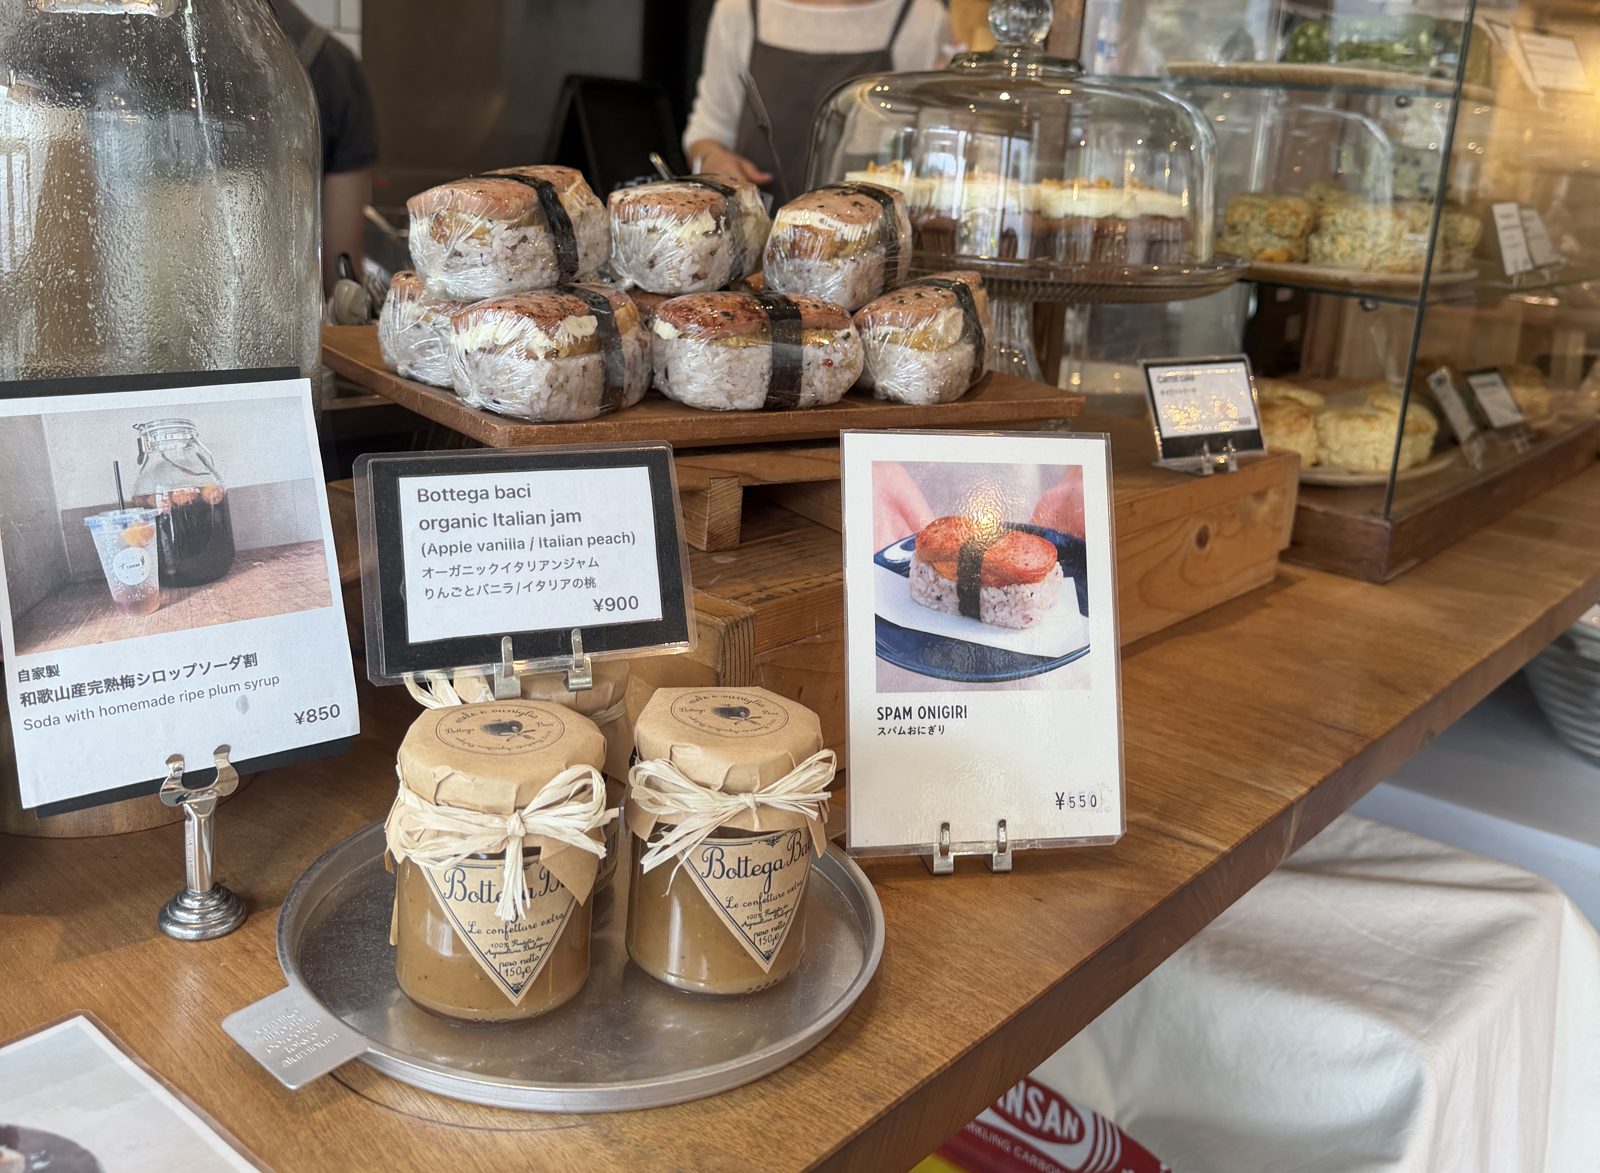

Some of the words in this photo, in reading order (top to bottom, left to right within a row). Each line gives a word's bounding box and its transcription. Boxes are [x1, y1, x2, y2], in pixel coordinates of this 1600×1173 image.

[417, 487, 490, 504] Bottega
[494, 483, 532, 500] baci
[419, 512, 488, 532] organic
[493, 510, 546, 527] Italian
[550, 509, 582, 527] jam
[421, 541, 473, 558] (Apple
[476, 537, 525, 552] vanilla
[538, 534, 583, 549] Italian
[587, 531, 636, 548] peach)
[422, 557, 600, 579] オーガニックイタリアンジャム
[593, 595, 639, 612] ¥900
[18, 664, 61, 683] 自家製
[19, 652, 259, 708] 和歌山産完熟梅シロップソーダ割
[23, 711, 61, 731] Soda
[65, 706, 95, 723] with
[99, 693, 175, 718] homemade
[179, 686, 205, 706] ripe
[208, 682, 241, 702] plum
[244, 674, 281, 694] syrup
[876, 706, 913, 721] SPAM
[917, 704, 968, 720] ONIGIRI
[293, 703, 341, 726] ¥850
[877, 724, 945, 736] スパムおにぎり
[1055, 791, 1098, 811] ¥550
[701, 846, 785, 894] Bottega
[467, 920, 482, 935] Le
[997, 1079, 1079, 1141] NSAN
